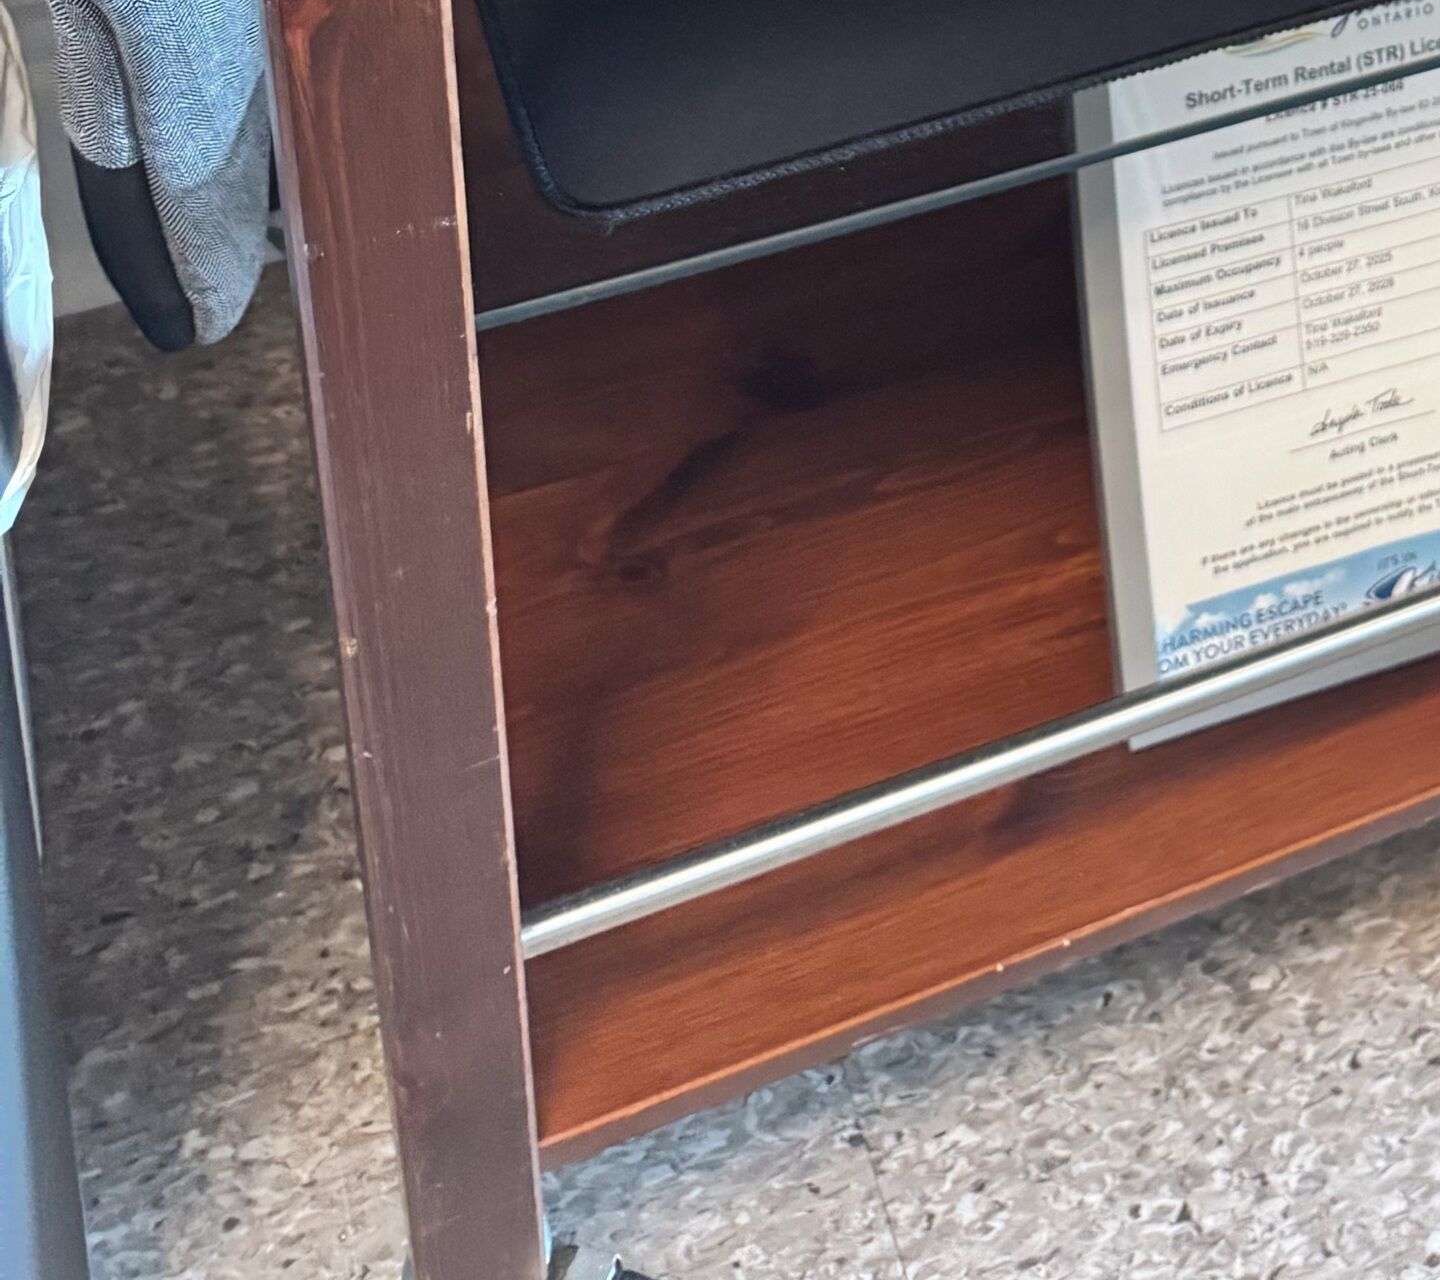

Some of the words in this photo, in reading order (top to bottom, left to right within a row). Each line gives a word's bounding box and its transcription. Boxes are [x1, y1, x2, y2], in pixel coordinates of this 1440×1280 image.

[1356, 2, 1434, 30] ONTARIO
[1184, 69, 1288, 109] Short-Term
[1293, 55, 1351, 84] Rental
[1356, 42, 1405, 71] (STR)
[1243, 206, 1258, 219] To
[1255, 588, 1324, 624] ESCAPE
[1192, 632, 1246, 664] YOUR
